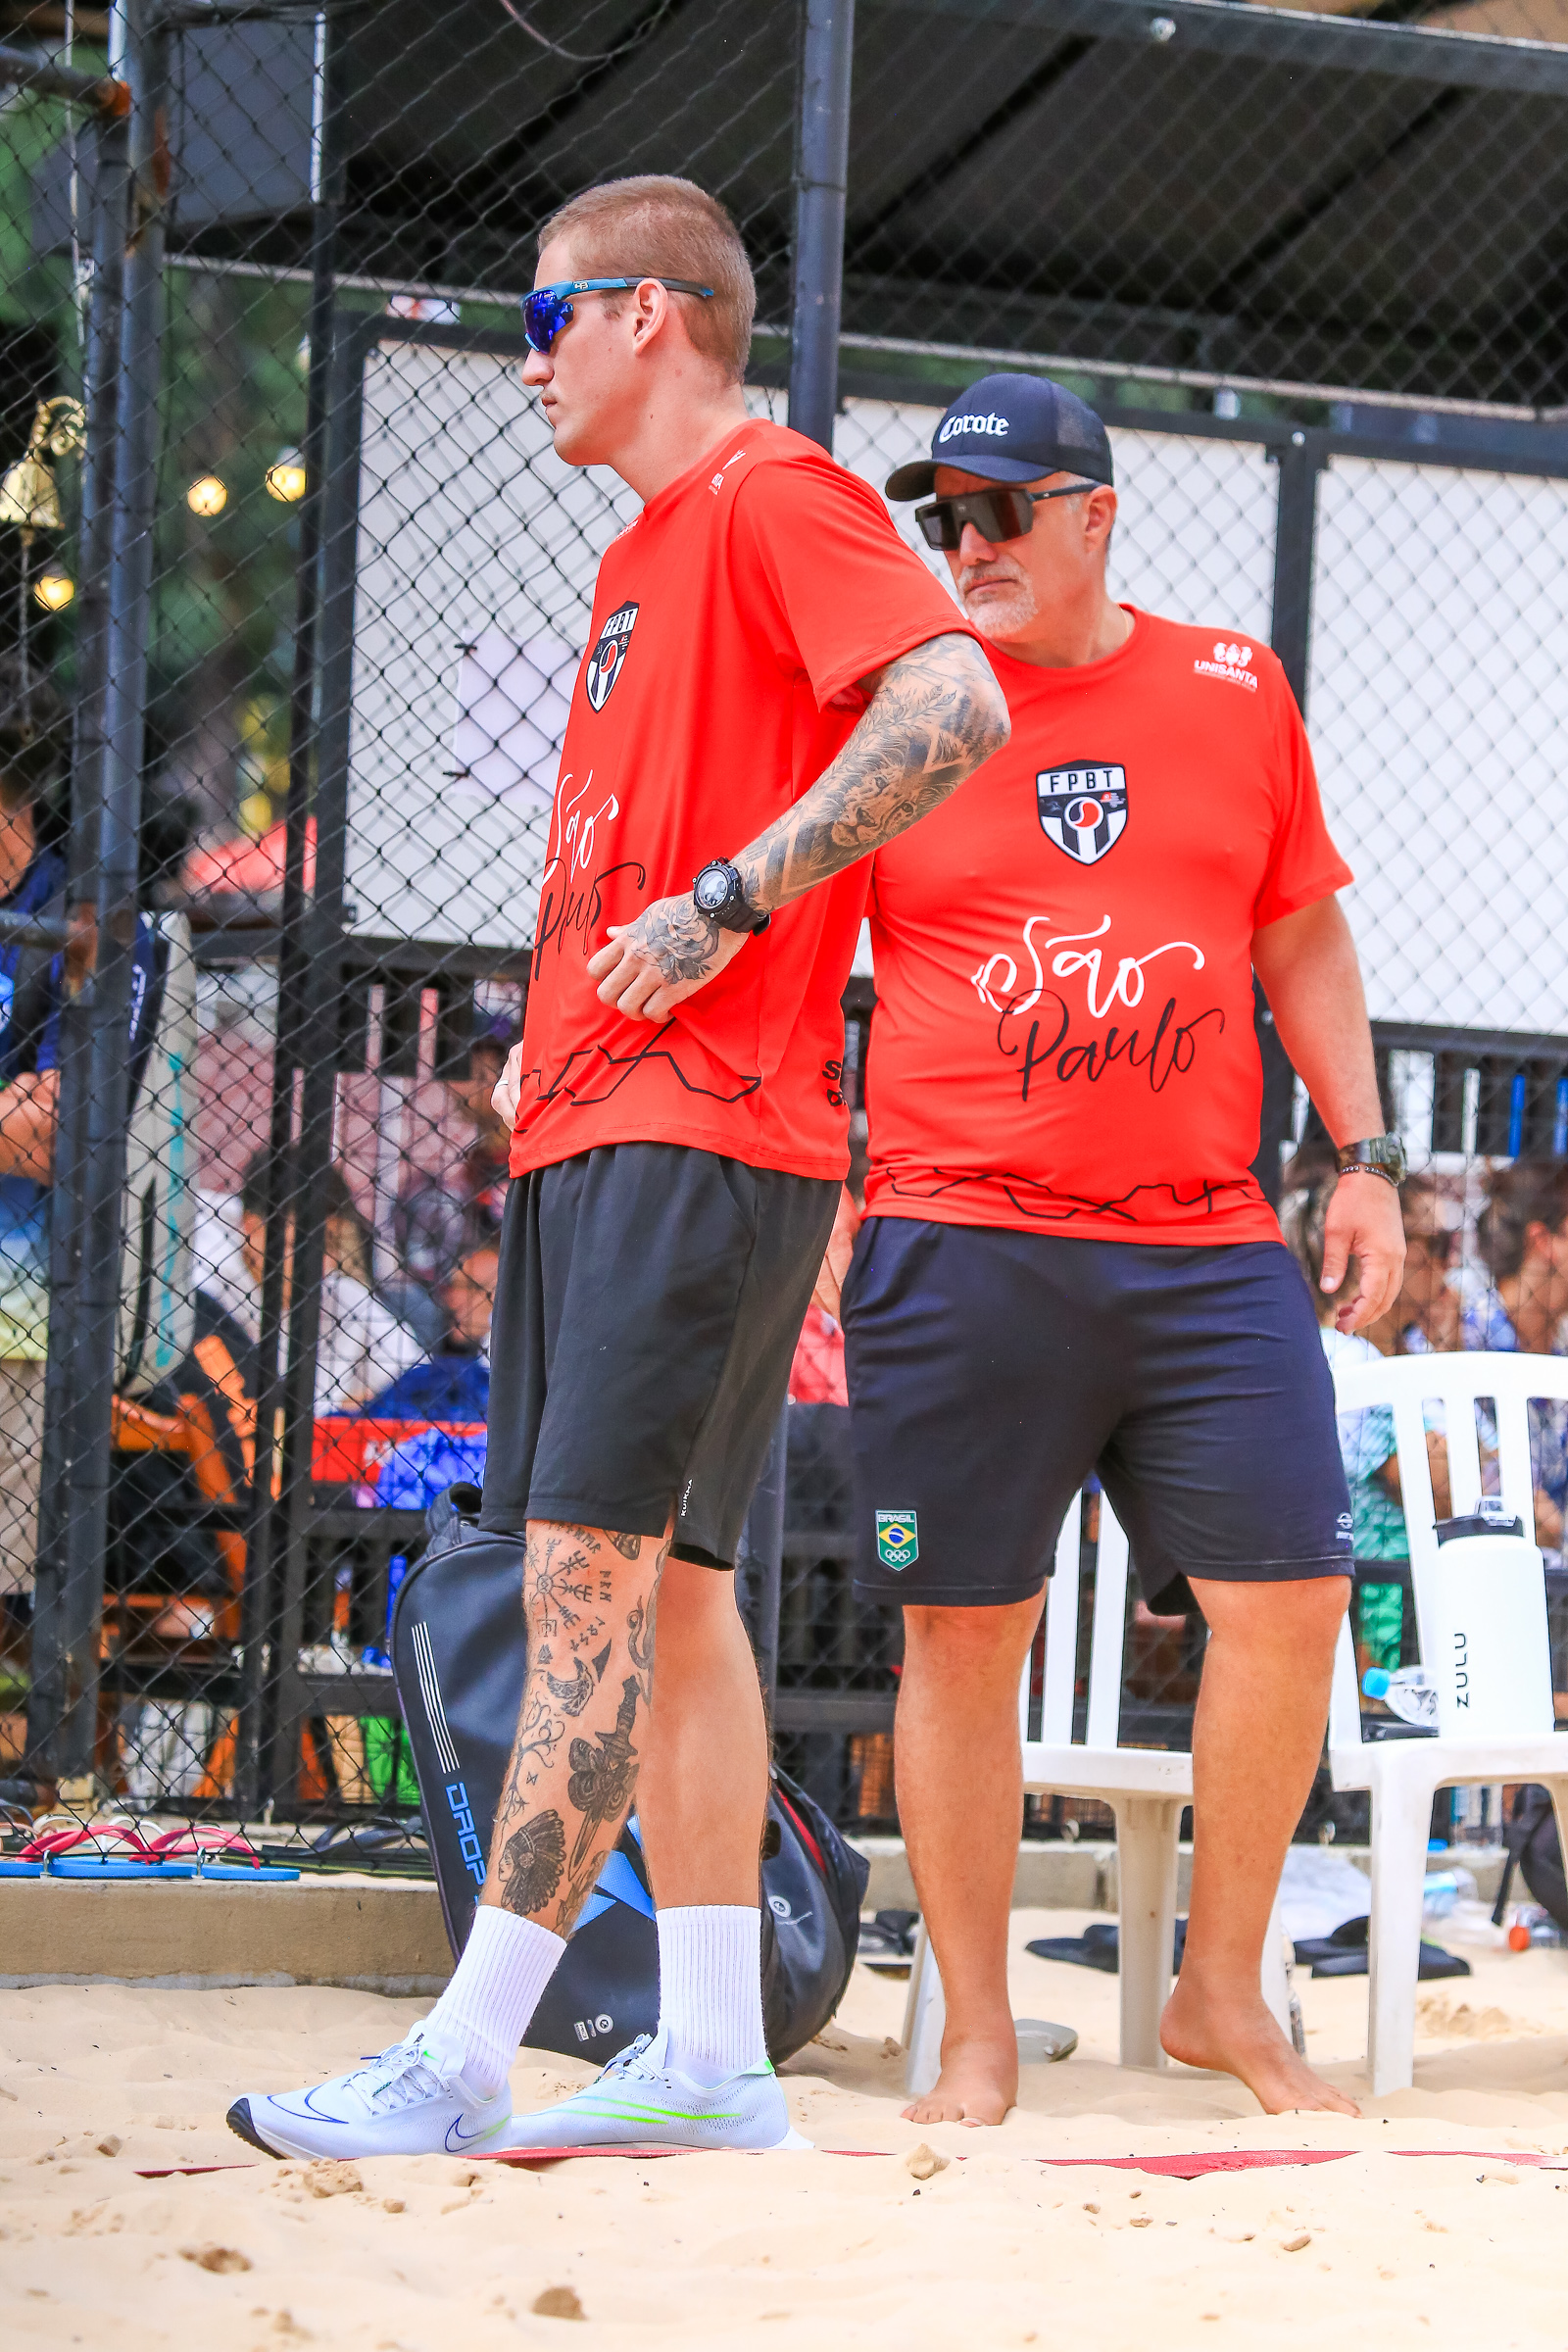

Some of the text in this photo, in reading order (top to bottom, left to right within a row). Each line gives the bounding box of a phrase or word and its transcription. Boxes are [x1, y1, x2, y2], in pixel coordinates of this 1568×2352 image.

[939, 412, 1010, 444] Corote
[604, 610, 635, 637] FPBT
[1194, 659, 1258, 689] UNISANTA
[1050, 769, 1112, 793] FPBT
[970, 913, 1205, 1019] São
[997, 988, 1226, 1102] Paulo
[877, 1513, 916, 1524] BRASIL
[1453, 1632, 1470, 1709] ZULU
[446, 1782, 487, 1886] DROP
